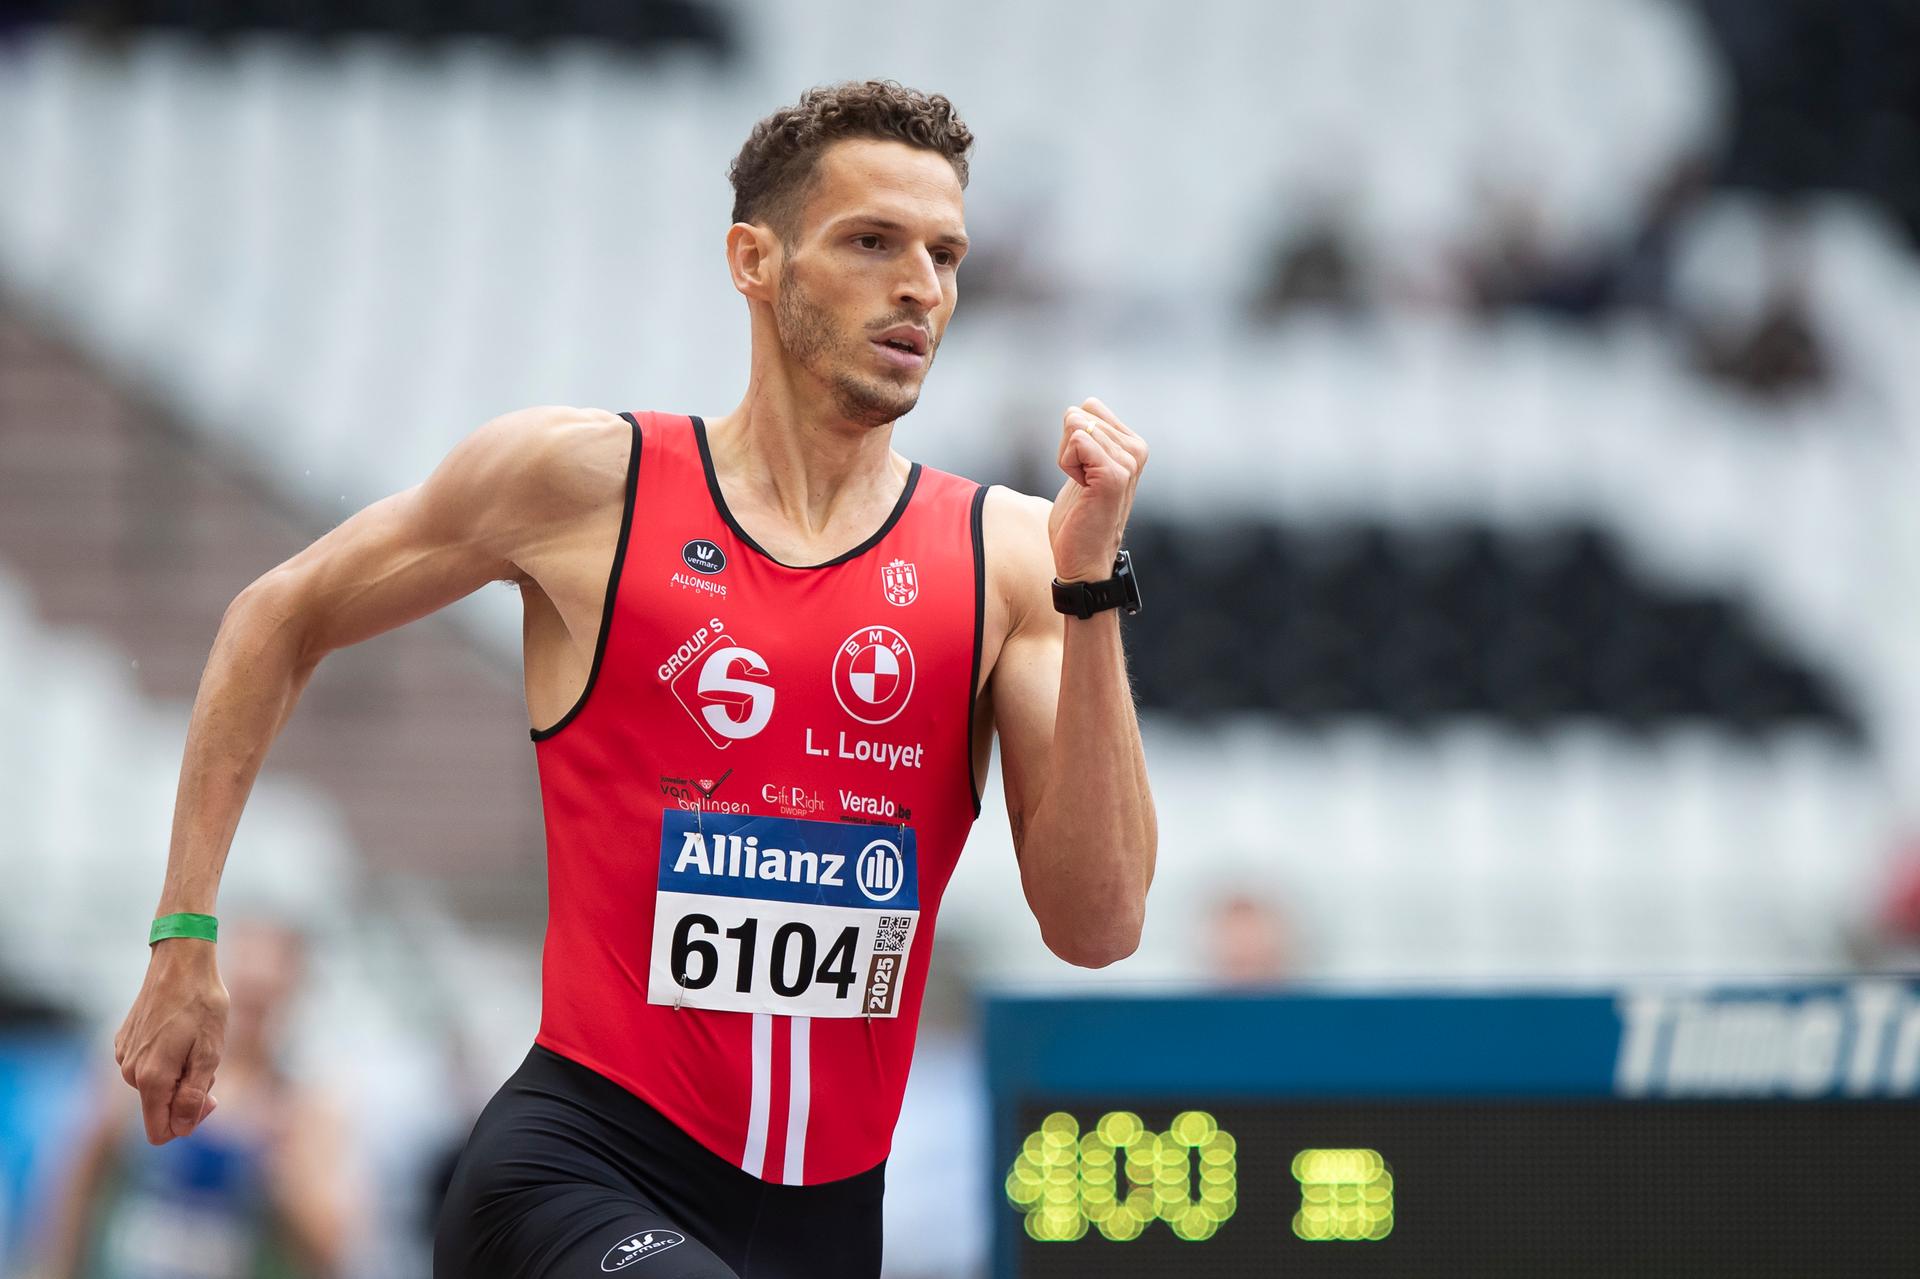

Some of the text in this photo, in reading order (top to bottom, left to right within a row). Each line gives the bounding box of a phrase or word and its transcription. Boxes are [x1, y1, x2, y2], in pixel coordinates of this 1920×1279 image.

[687, 556, 718, 570] vermarc
[671, 572, 727, 596] ALLONSIUS
[658, 618, 724, 681] GROUP S
[845, 630, 906, 657] BMW
[805, 728, 924, 770] L. Louyet
[660, 784, 690, 799] van
[761, 783, 825, 813] Gift Right
[780, 806, 808, 816] DWORP
[673, 832, 846, 887] Allianz
[670, 913, 860, 999] 6104
[869, 957, 895, 1010] 2025
[1005, 1111, 1236, 1242] 400
[616, 1239, 676, 1266] vermarc
